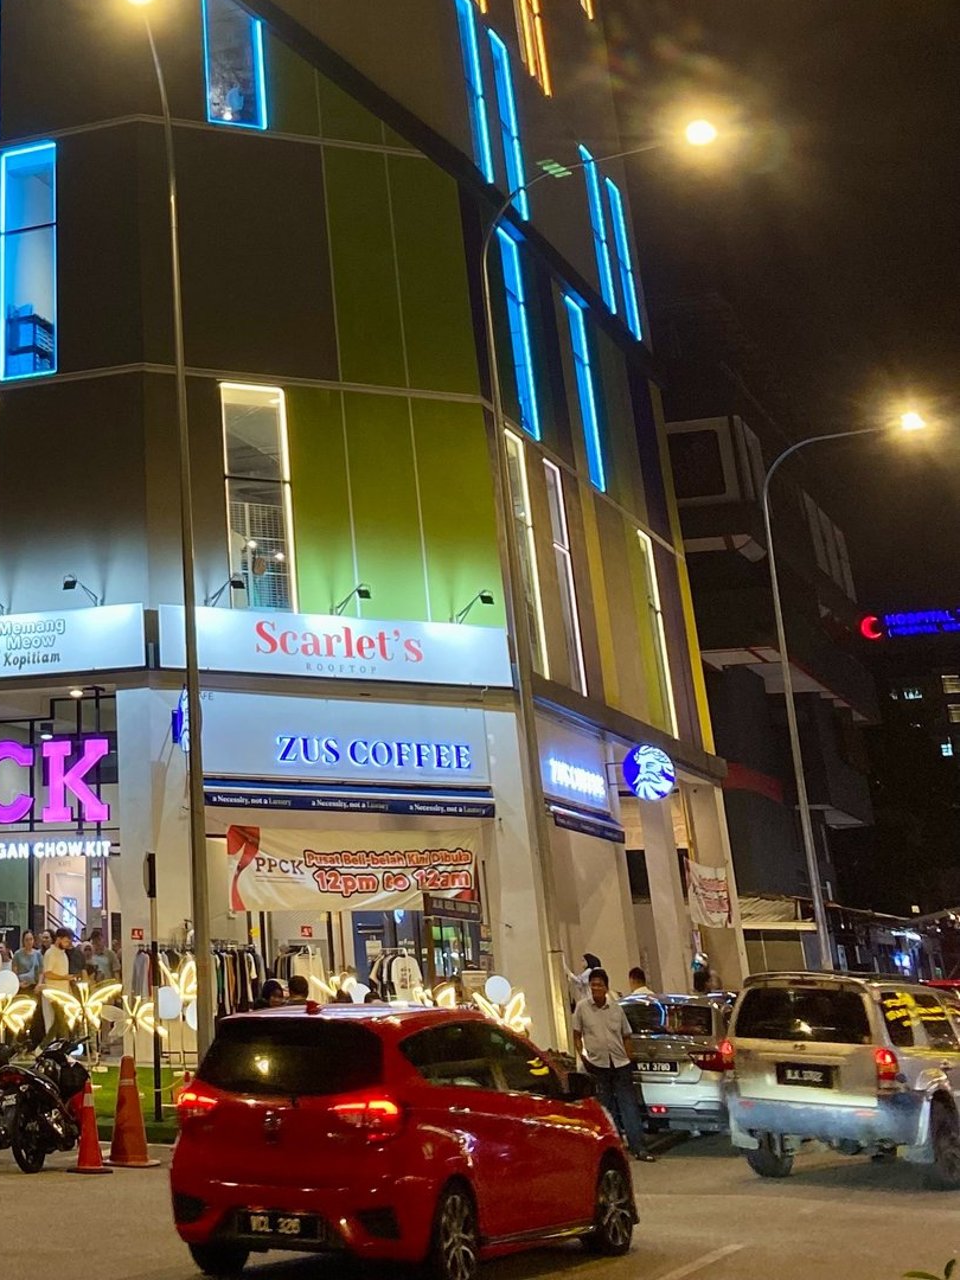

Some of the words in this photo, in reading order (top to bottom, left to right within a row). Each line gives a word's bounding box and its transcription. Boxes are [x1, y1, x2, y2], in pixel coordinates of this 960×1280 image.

[6, 634, 55, 651] Meow
[255, 620, 423, 663] Scarlet's
[3, 651, 61, 670] Kopitiam
[306, 663, 377, 674] ROOFTOP
[277, 735, 340, 764] ZUS
[348, 740, 472, 769] COFFEE
[33, 840, 84, 858] CHOW
[86, 840, 111, 858] KIT
[304, 850, 340, 868] Pusat
[340, 850, 406, 868] Beli-belah
[406, 850, 430, 868] Kini
[430, 848, 472, 865] Dibuka
[255, 857, 305, 875] PPCK
[313, 870, 379, 897] 12pm
[383, 870, 410, 892] to
[413, 868, 471, 892] 12am
